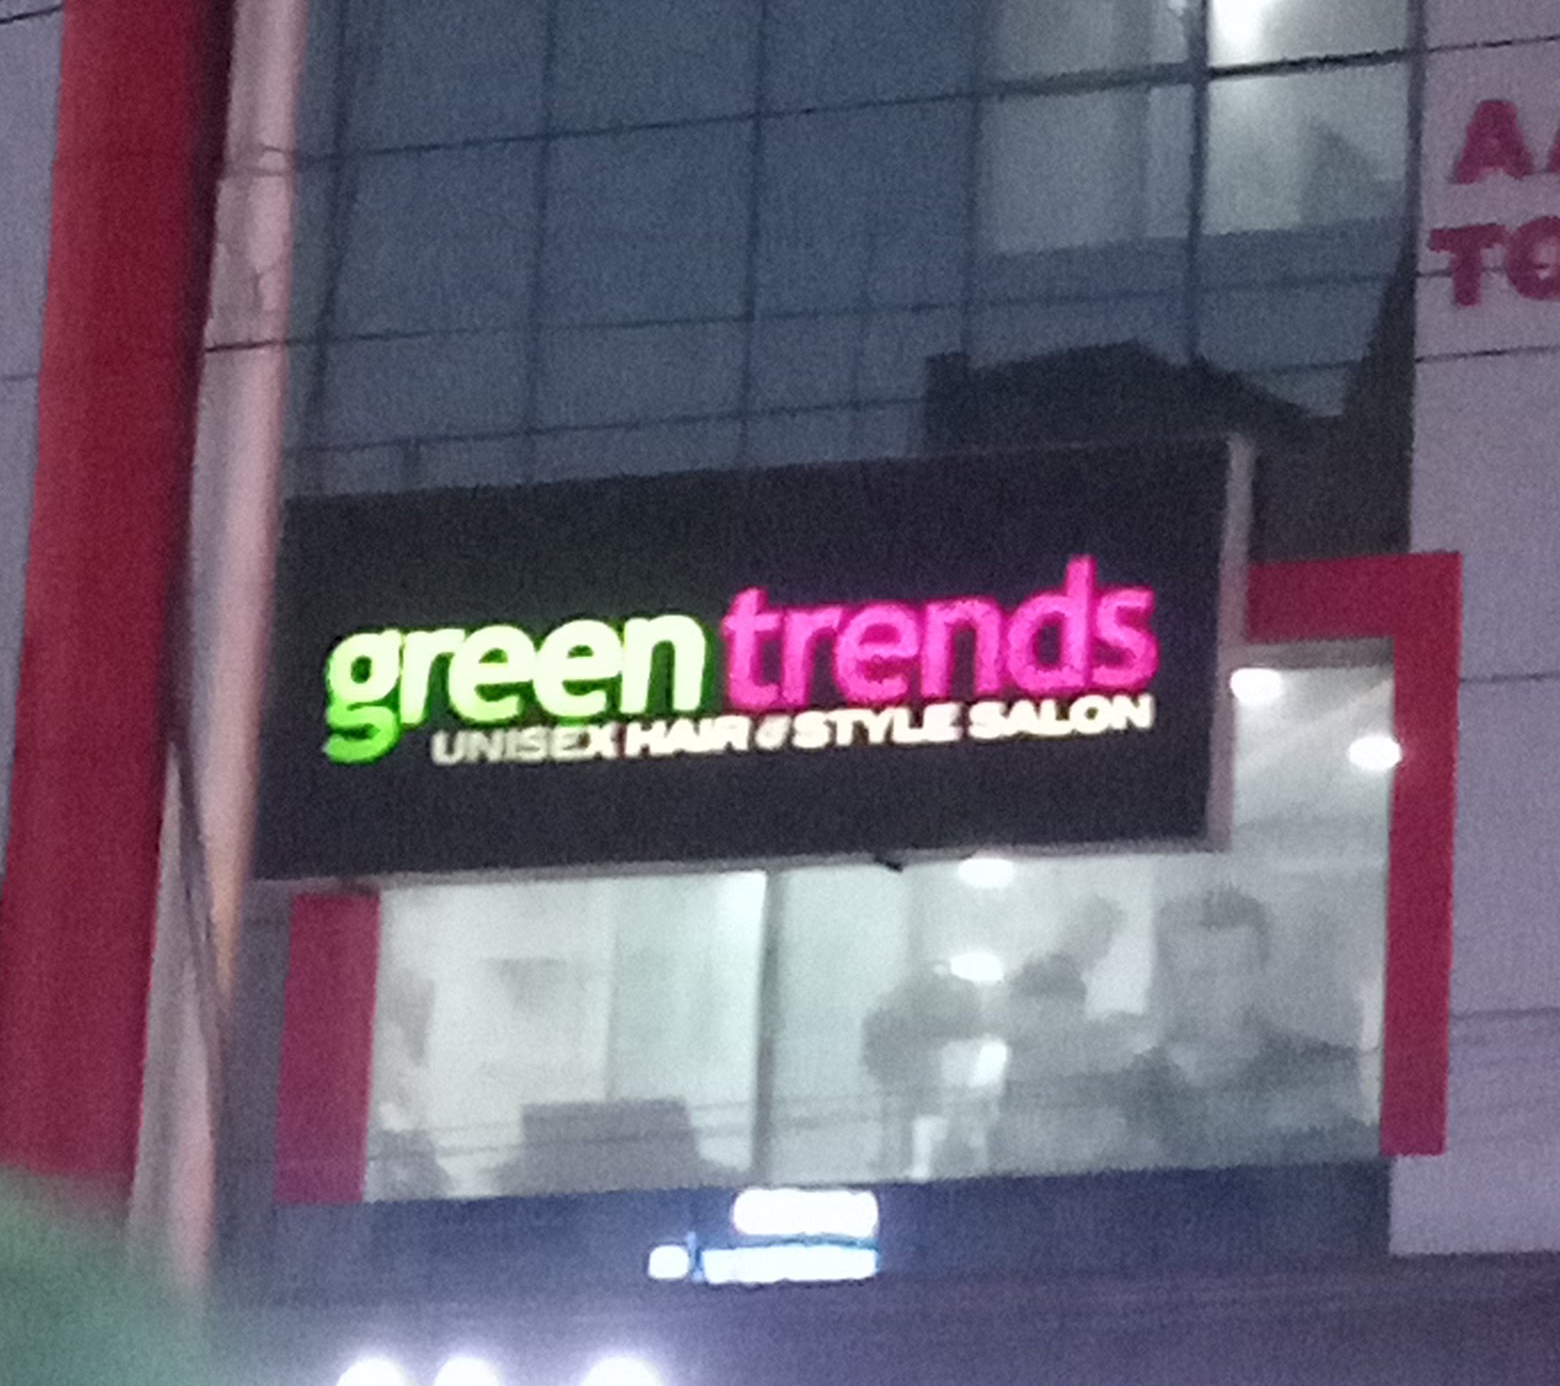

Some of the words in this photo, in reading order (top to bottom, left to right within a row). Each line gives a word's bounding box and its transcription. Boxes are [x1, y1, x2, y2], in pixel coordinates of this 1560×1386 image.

[324, 613, 708, 764] green
[720, 553, 1160, 711] trends
[431, 722, 620, 764] UNISEX
[624, 716, 750, 755] HAIR
[793, 702, 962, 749] STYLE
[967, 692, 1156, 740] SALON
